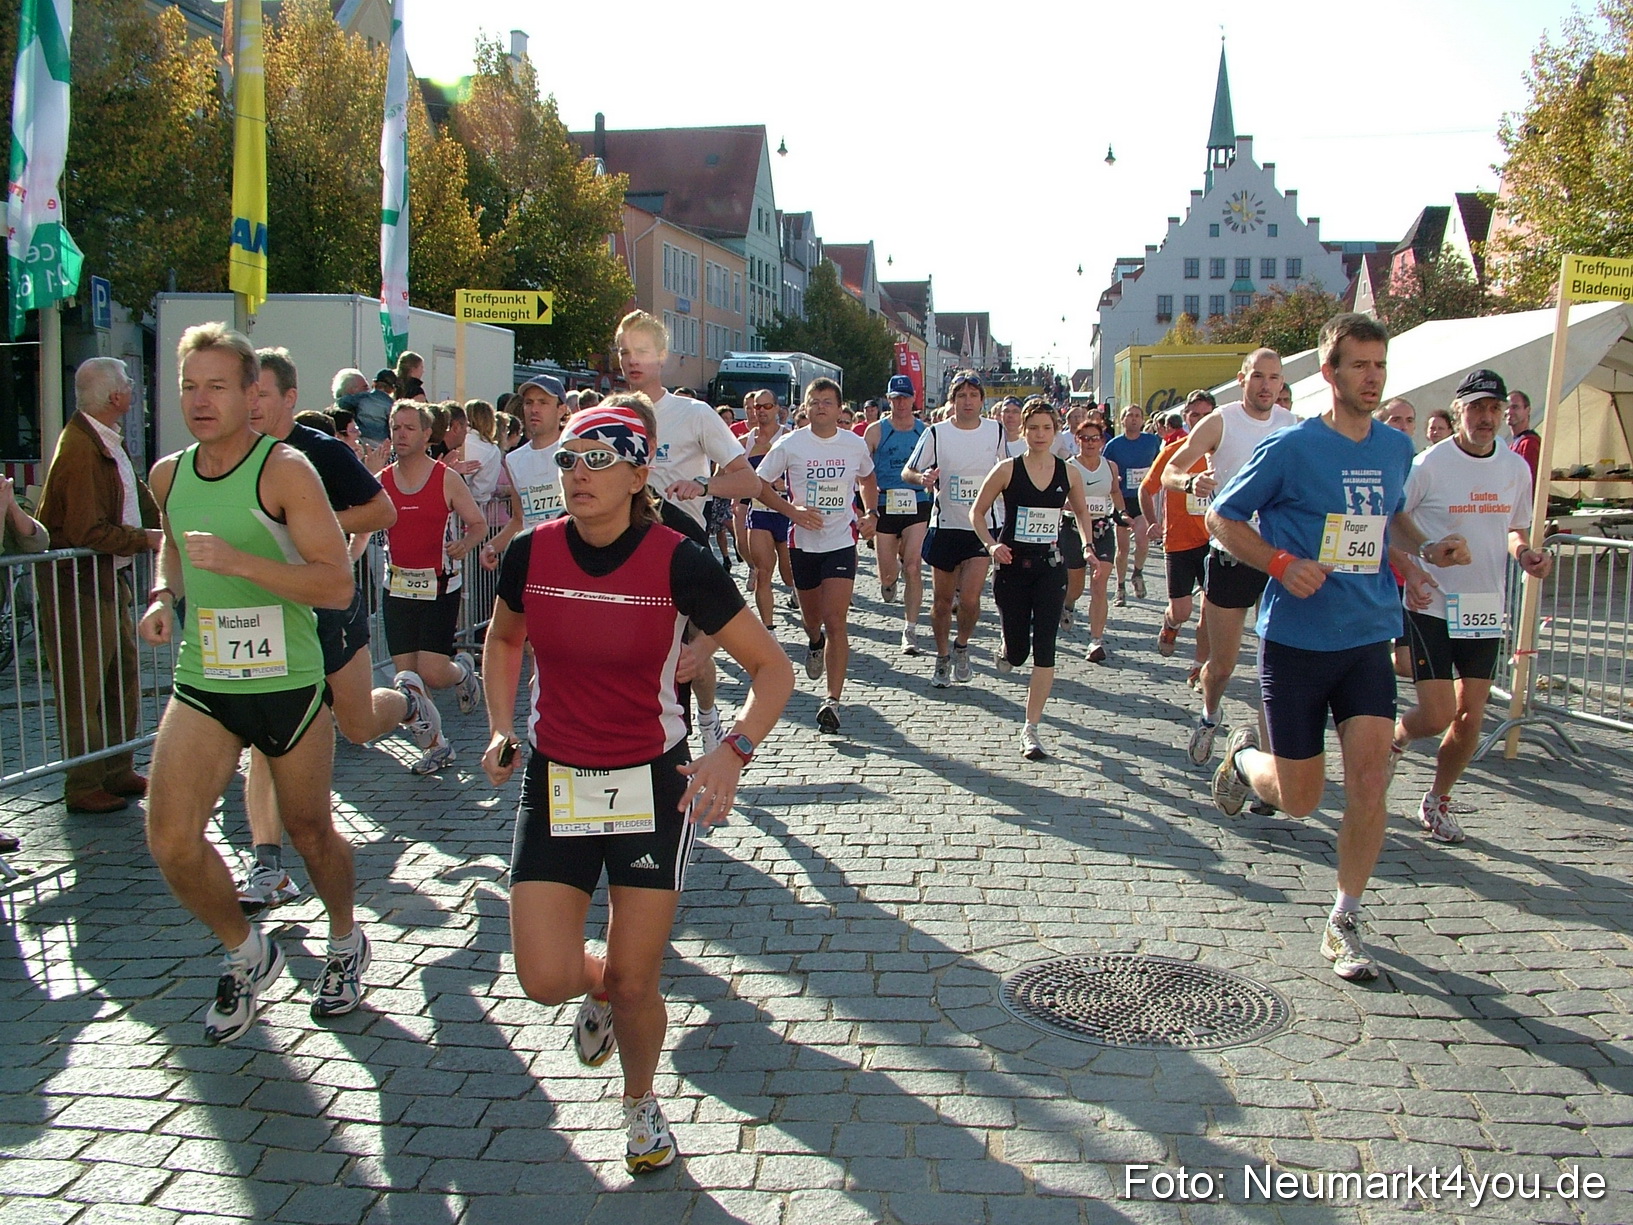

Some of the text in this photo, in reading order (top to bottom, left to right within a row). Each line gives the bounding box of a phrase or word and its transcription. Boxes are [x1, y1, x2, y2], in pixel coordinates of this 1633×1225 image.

[1572, 280, 1633, 301] Bladenig
[96, 284, 106, 321] P
[463, 293, 527, 306] Treffpunkt
[463, 307, 530, 321] Bladenight
[806, 459, 822, 467] 20.
[806, 467, 846, 479] 2007
[529, 483, 554, 493] Stephan
[818, 484, 838, 492] Michael
[960, 489, 979, 498] 318
[1470, 492, 1498, 501] Laufen
[533, 495, 562, 511] 2772
[818, 496, 844, 506] 2209
[897, 499, 912, 508] 347
[1196, 498, 1207, 507] 11
[1086, 504, 1104, 512] 1082
[1448, 503, 1476, 513] macht
[1029, 510, 1046, 519] Britta
[1028, 523, 1055, 534] 2752
[1344, 520, 1368, 534] Roger
[1347, 541, 1376, 557] 540
[218, 613, 260, 629] Michael
[1462, 613, 1498, 626] 3525
[228, 638, 272, 660] 714
[554, 785, 619, 810] B 7
[615, 819, 653, 829] PFLEIDERER
[630, 862, 660, 870] adidas
